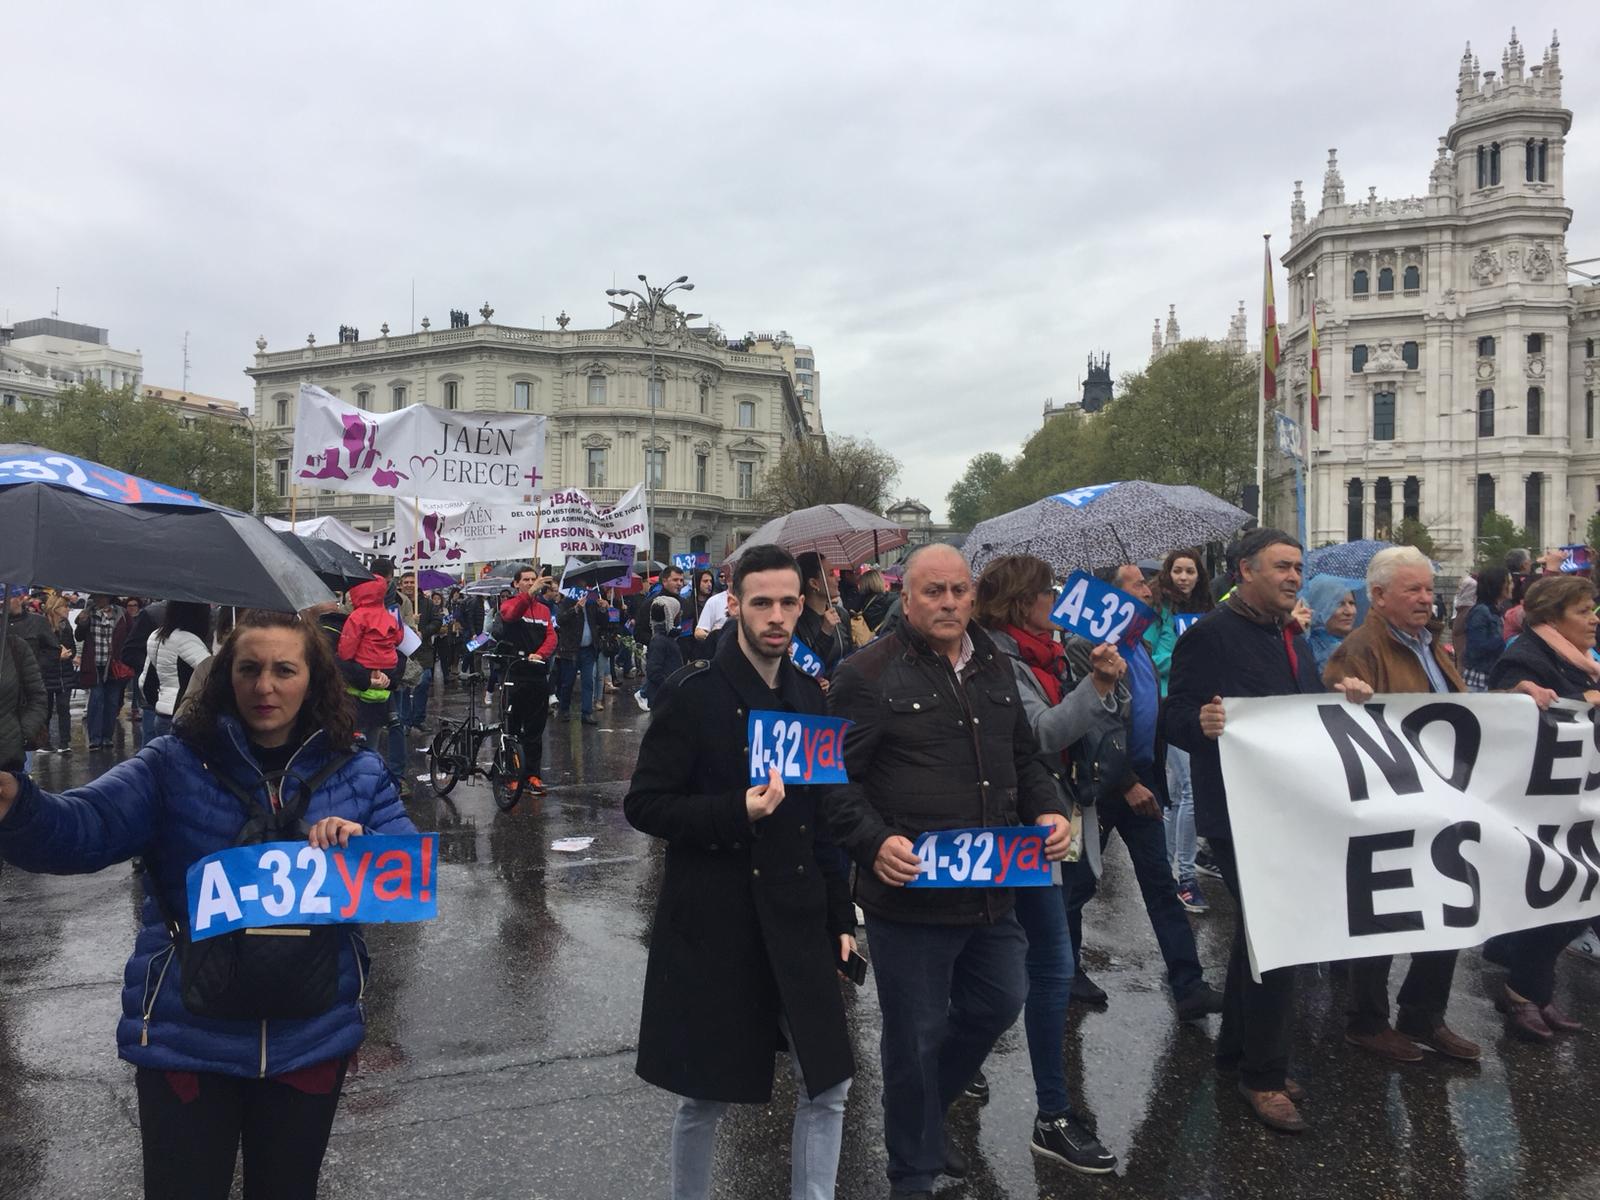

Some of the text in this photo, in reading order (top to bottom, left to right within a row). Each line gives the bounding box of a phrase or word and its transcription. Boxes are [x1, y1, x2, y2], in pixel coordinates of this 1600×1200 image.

[434, 421, 516, 456] JAÉN
[460, 507, 492, 526] JAÉN
[598, 530, 605, 539] Y
[560, 542, 588, 552] PARA
[675, 555, 696, 570] A-32
[1053, 578, 1135, 643] A-32
[750, 719, 849, 781] A-32 ya!
[1317, 703, 1482, 802] NO
[914, 832, 994, 882] A-32
[1346, 821, 1482, 937] ES
[196, 837, 433, 931] A-32 ya!
